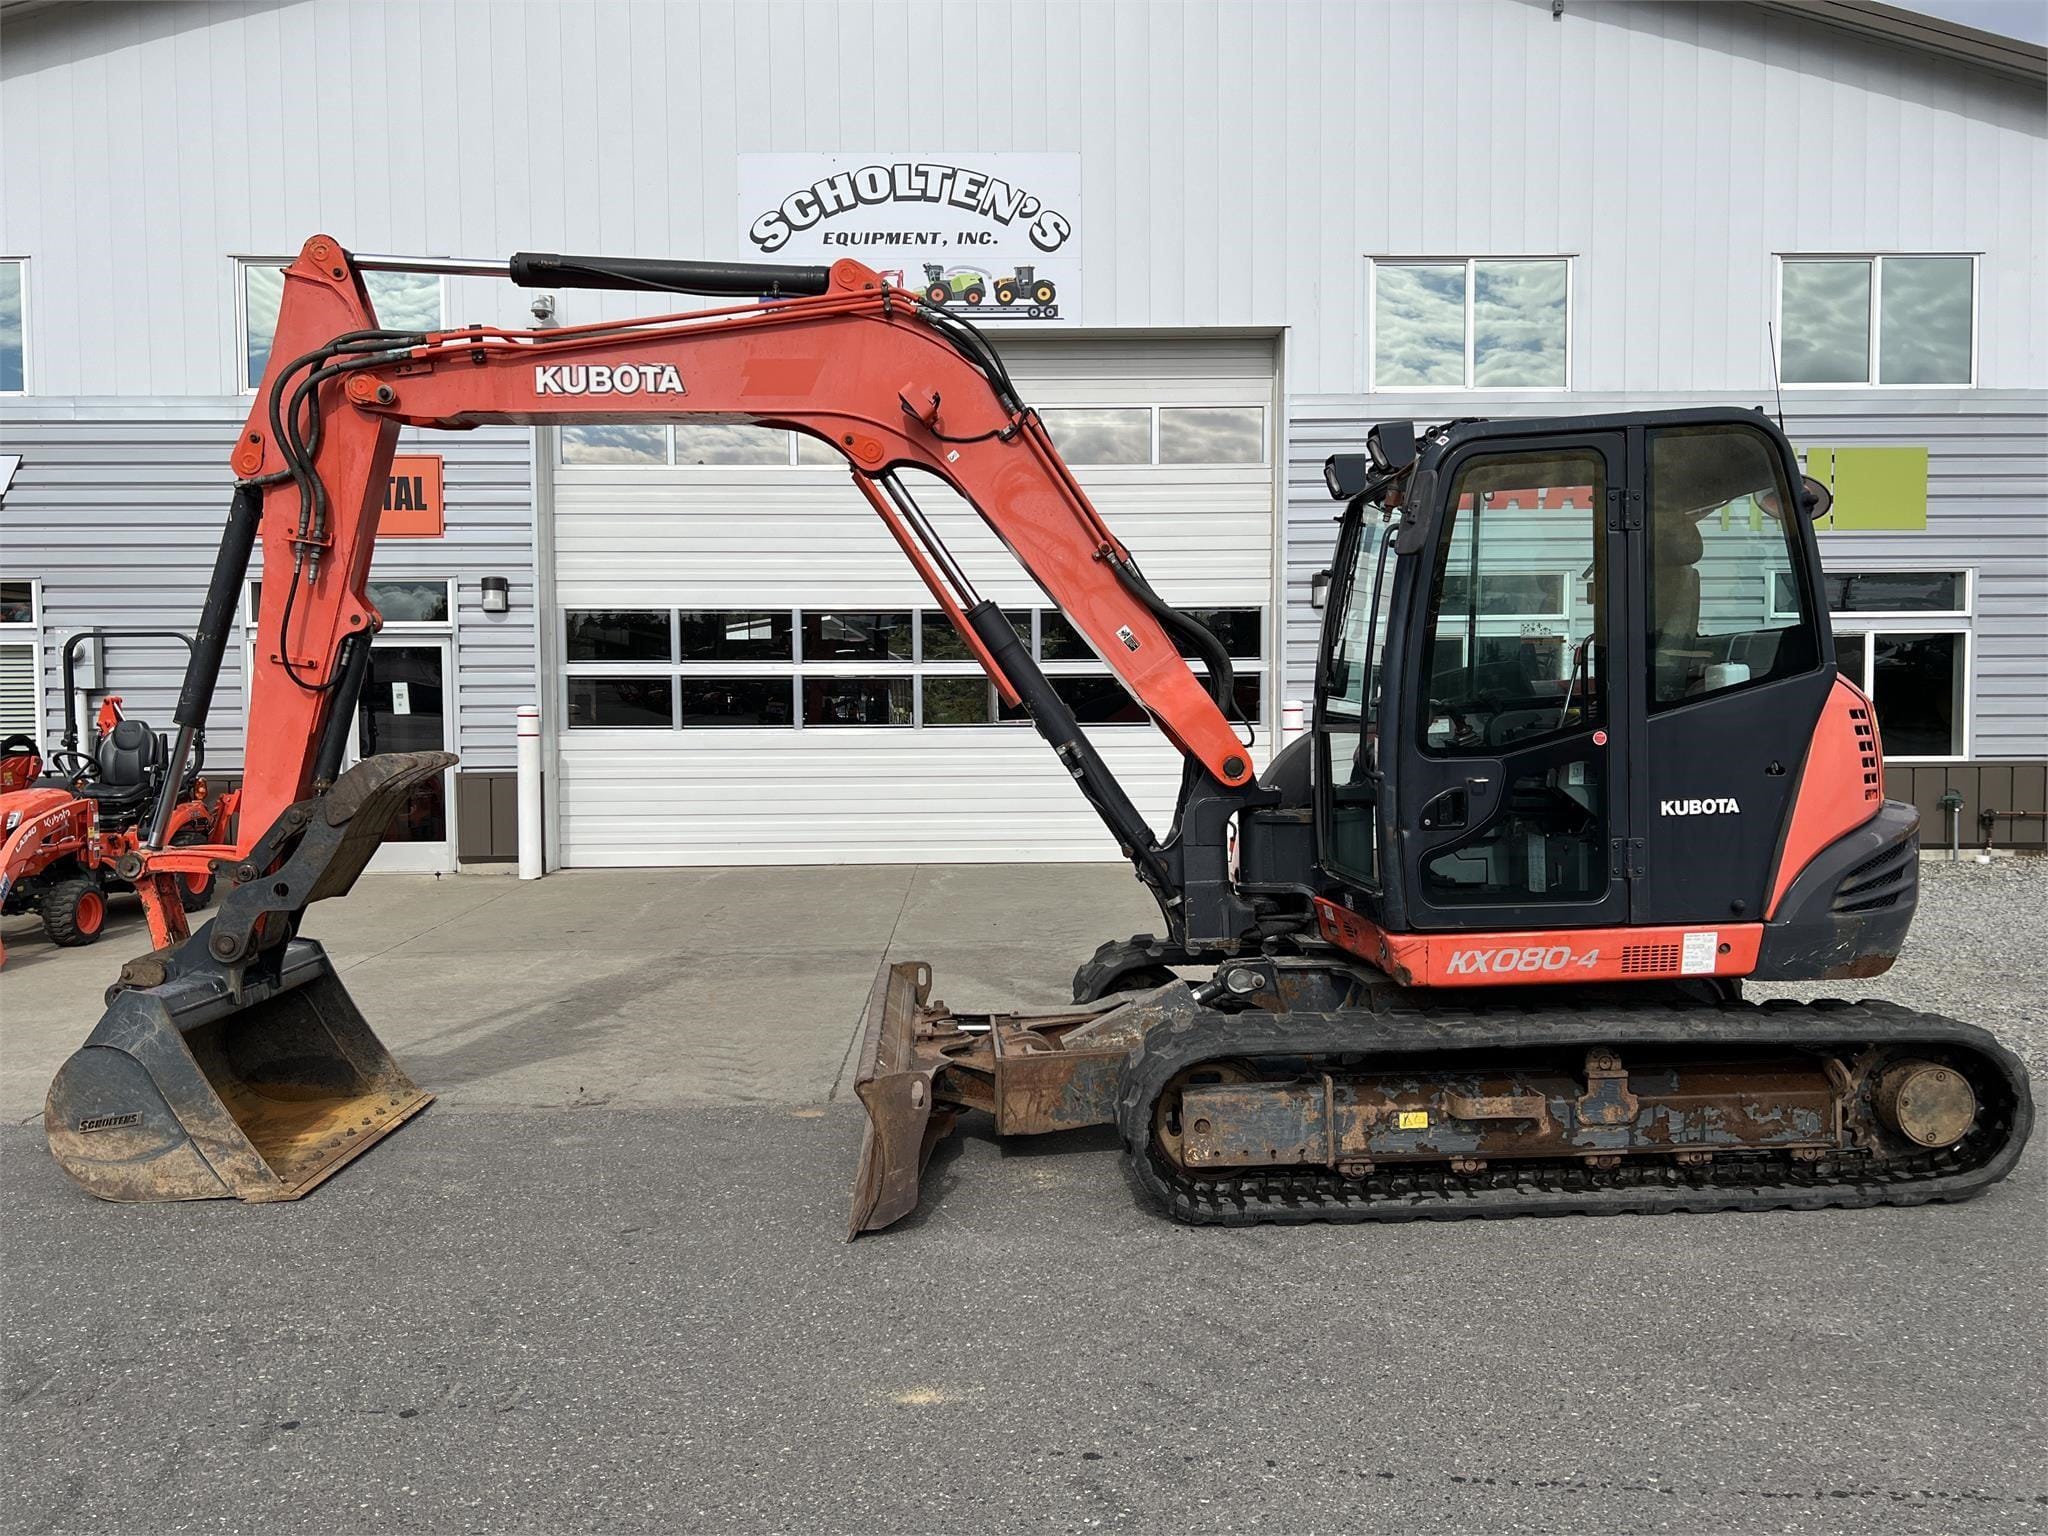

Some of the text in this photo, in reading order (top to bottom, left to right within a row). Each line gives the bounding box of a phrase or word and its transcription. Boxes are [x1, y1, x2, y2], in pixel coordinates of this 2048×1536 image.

[749, 163, 1071, 253] SCHOLTEN'S
[822, 231, 999, 248] EQUIPMENT, INC.
[534, 363, 686, 395] KUBOTA
[1660, 798, 1740, 816] KUBOTA
[1446, 946, 1600, 975] KX080-4
